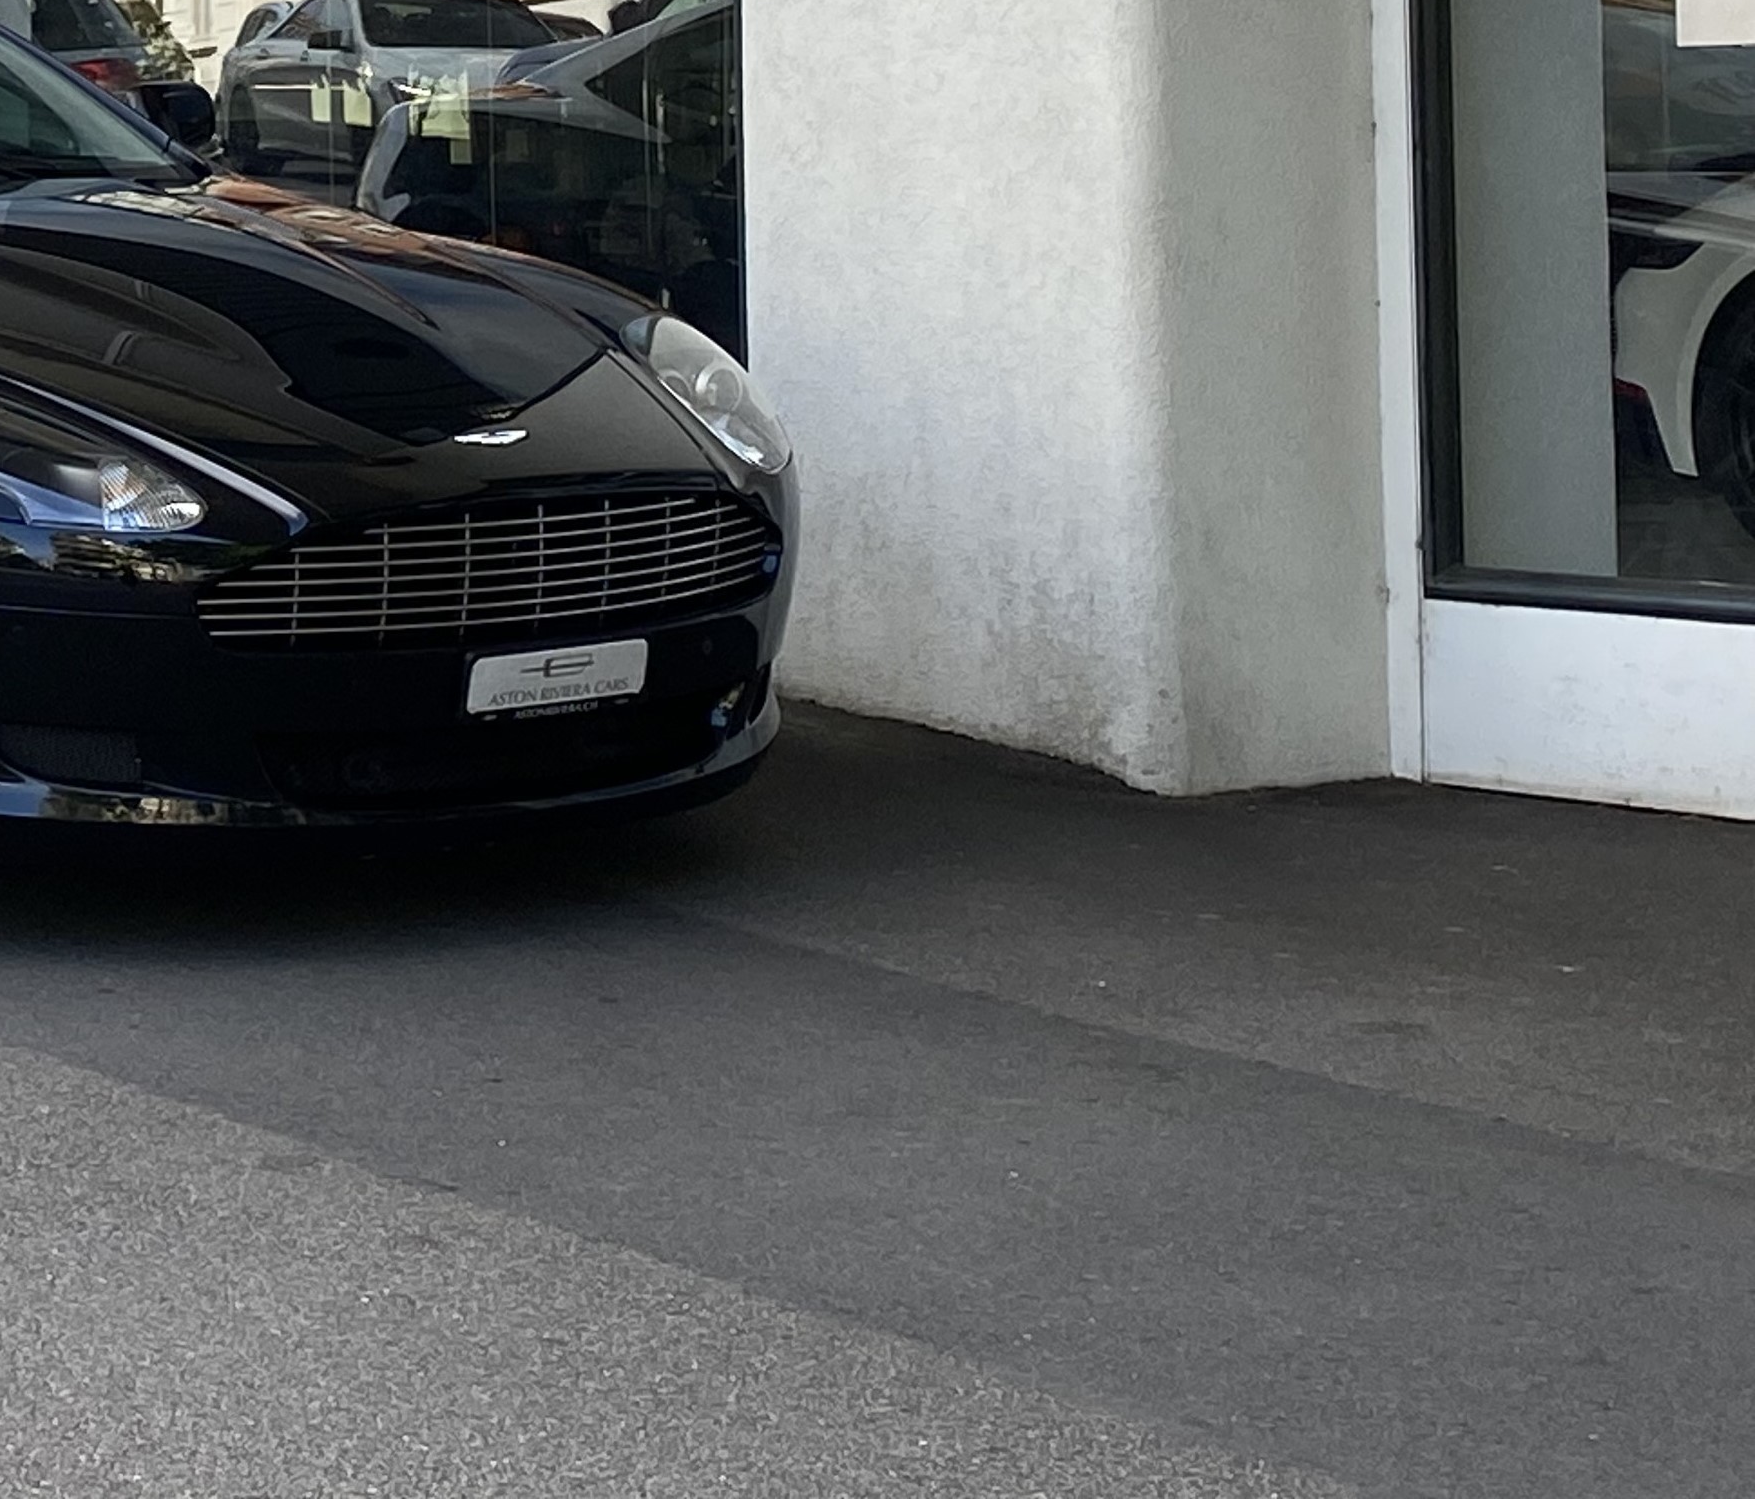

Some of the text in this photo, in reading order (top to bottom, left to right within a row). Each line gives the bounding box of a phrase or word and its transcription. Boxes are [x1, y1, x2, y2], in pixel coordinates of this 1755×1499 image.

[488, 677, 629, 707] ASTON RIVIERA CARS
